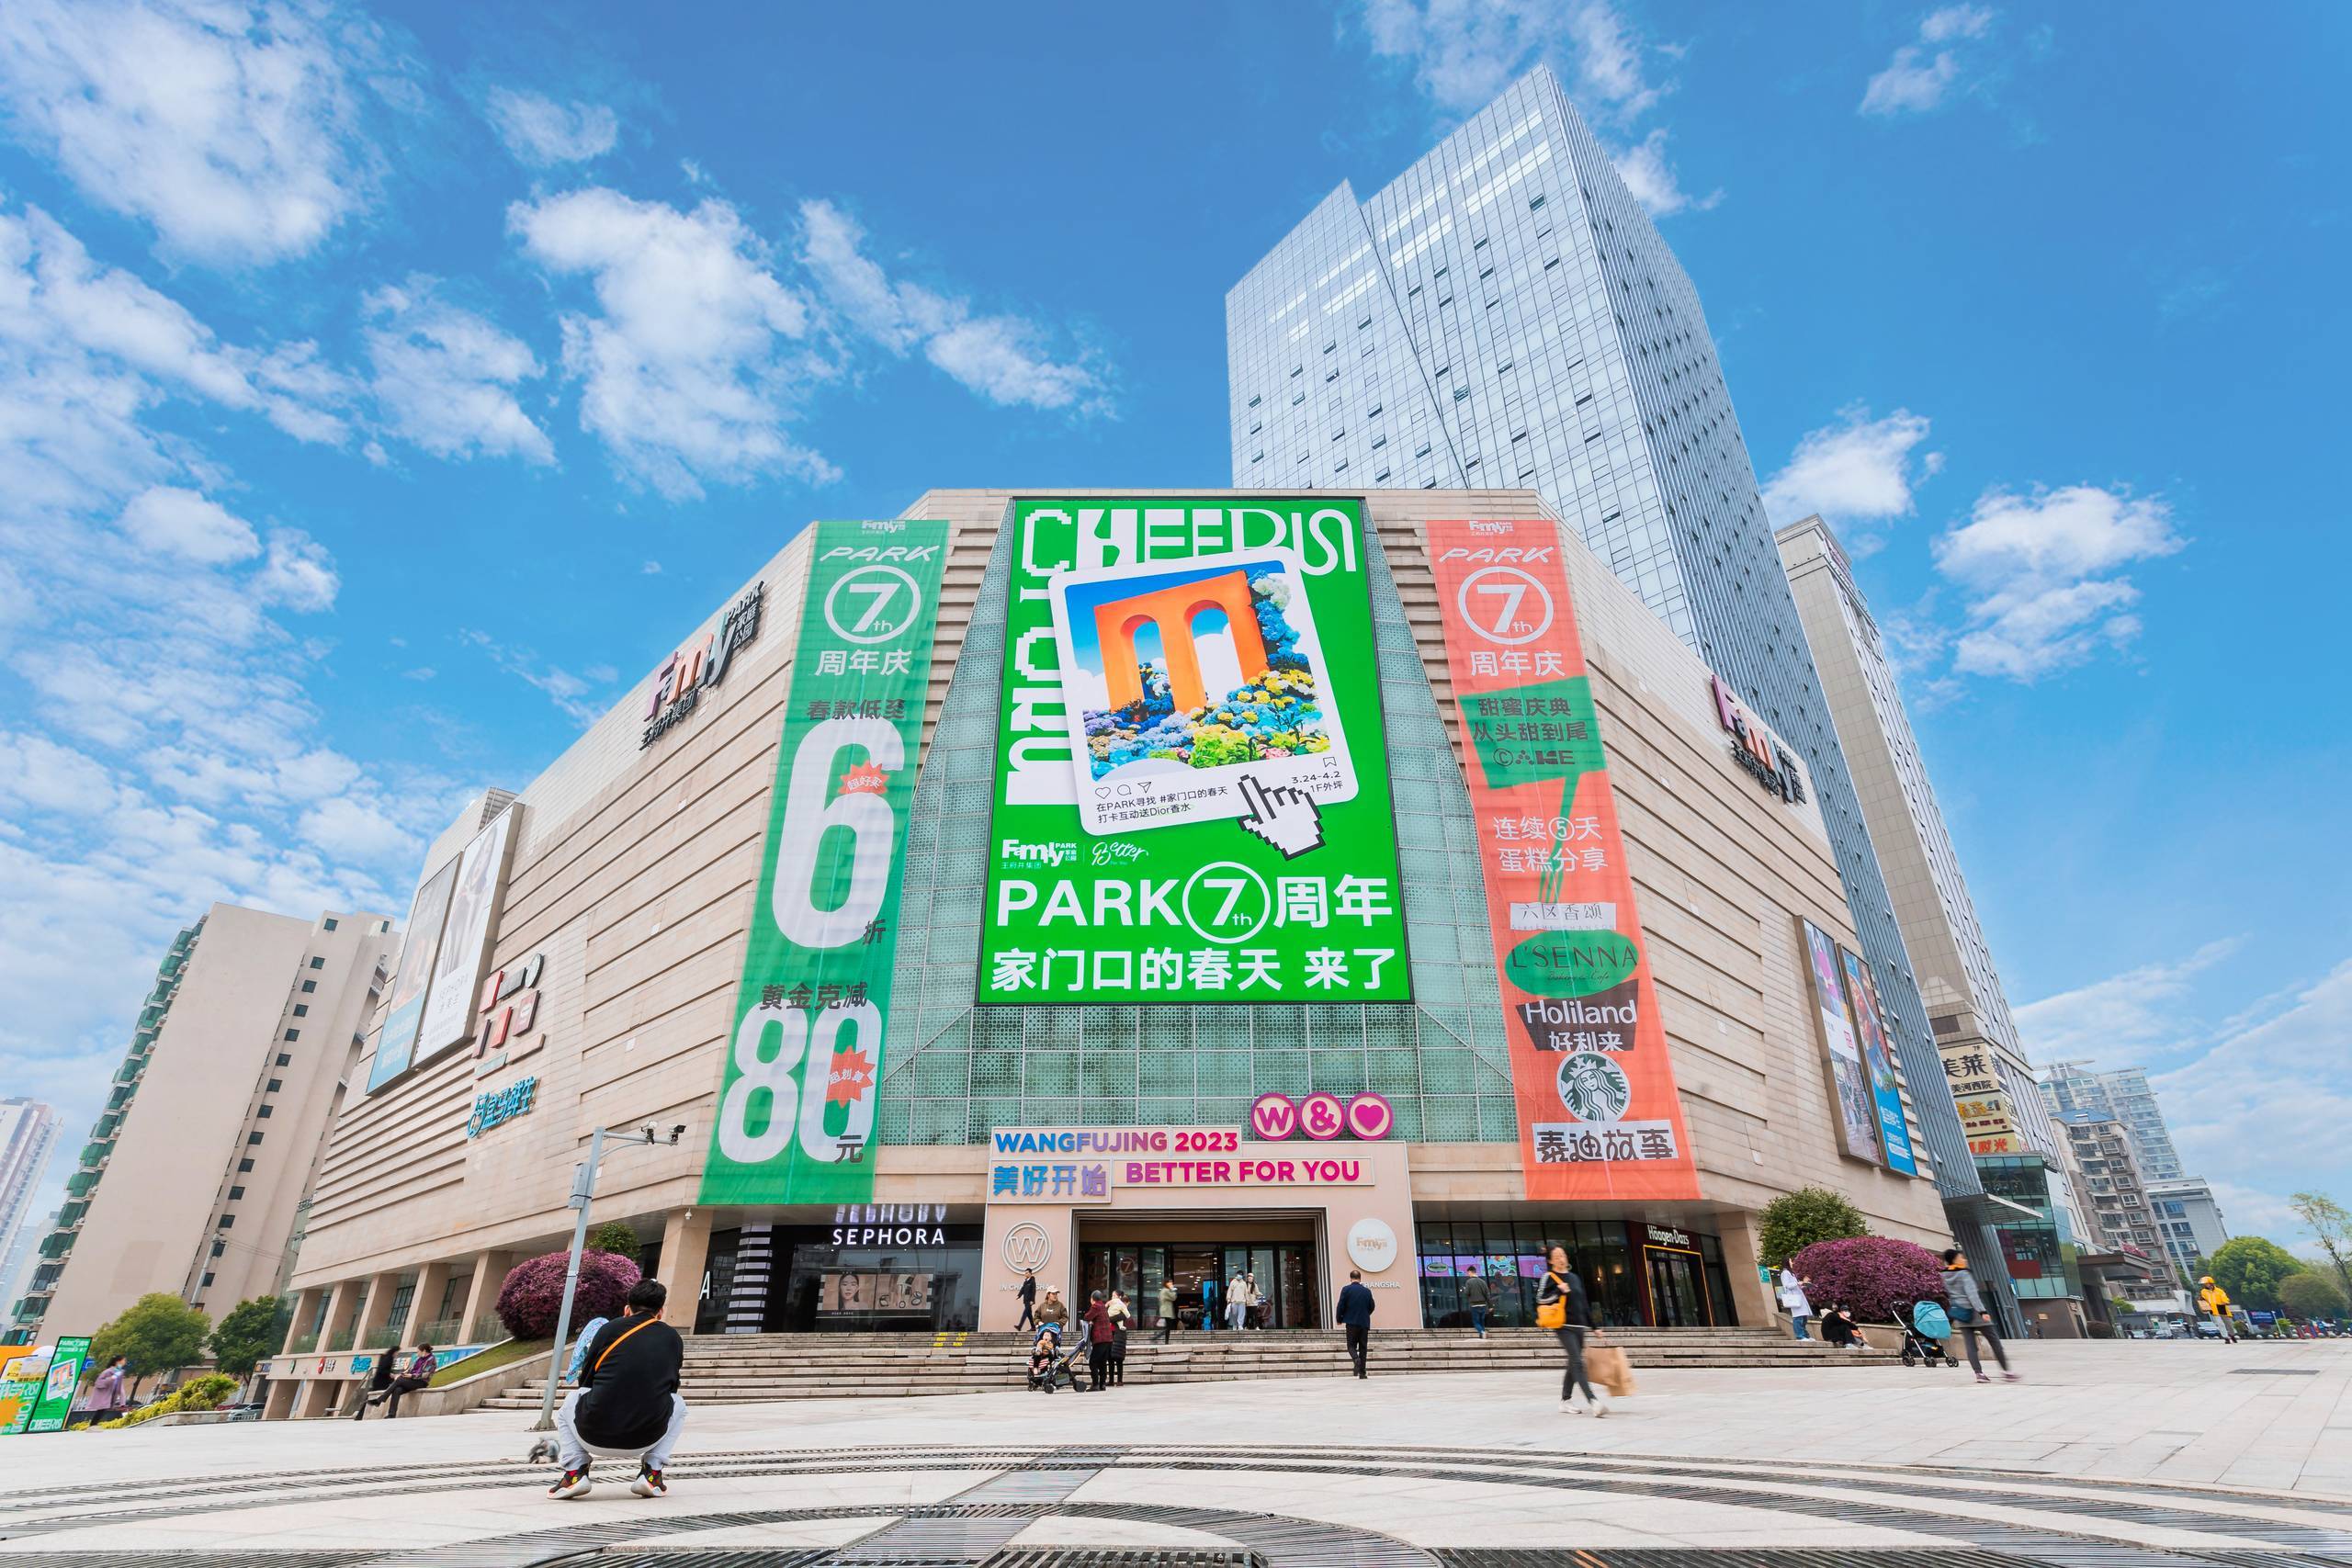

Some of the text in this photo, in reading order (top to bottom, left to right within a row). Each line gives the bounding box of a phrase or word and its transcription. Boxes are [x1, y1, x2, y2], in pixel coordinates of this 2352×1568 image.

[820, 546, 941, 562] PARK
[1439, 547, 1555, 563] PARK
[726, 581, 764, 620] PARK
[814, 649, 912, 677] 周年庆
[1470, 650, 1566, 677] 周年庆
[807, 698, 905, 720] 春款低至
[1478, 698, 1572, 716] 甜蜜庆典
[1472, 721, 1589, 741] 从头甜到尾
[1292, 771, 1341, 784] 3.24-4.2
[1310, 781, 1343, 792] 1F外坪
[1096, 786, 1227, 812] 在PARK寻找 #家门口的春天
[1098, 803, 1191, 823] 打卡互动送Dior香水
[772, 714, 905, 948] 6
[1498, 846, 1609, 873] 蛋糕分享
[997, 878, 1183, 927] PARK
[1273, 874, 1393, 929] 周年
[862, 919, 887, 945] 折
[989, 947, 1396, 992] 家门口的春天 来了
[1511, 945, 1637, 968] L'SENNA
[759, 982, 869, 1010] 黄金克减
[1525, 998, 1637, 1024] Holiland
[1549, 1032, 1623, 1052] 好利来
[718, 998, 882, 1164] 80
[835, 1134, 864, 1164] 元
[995, 1132, 1238, 1153] WANGFUJING 2023
[1536, 1129, 1673, 1163] 泰迪故事
[993, 1163, 1106, 1197] 美好开始
[1126, 1160, 1360, 1183] BETTER FOR YOU
[832, 1228, 944, 1245] SEPHORA
